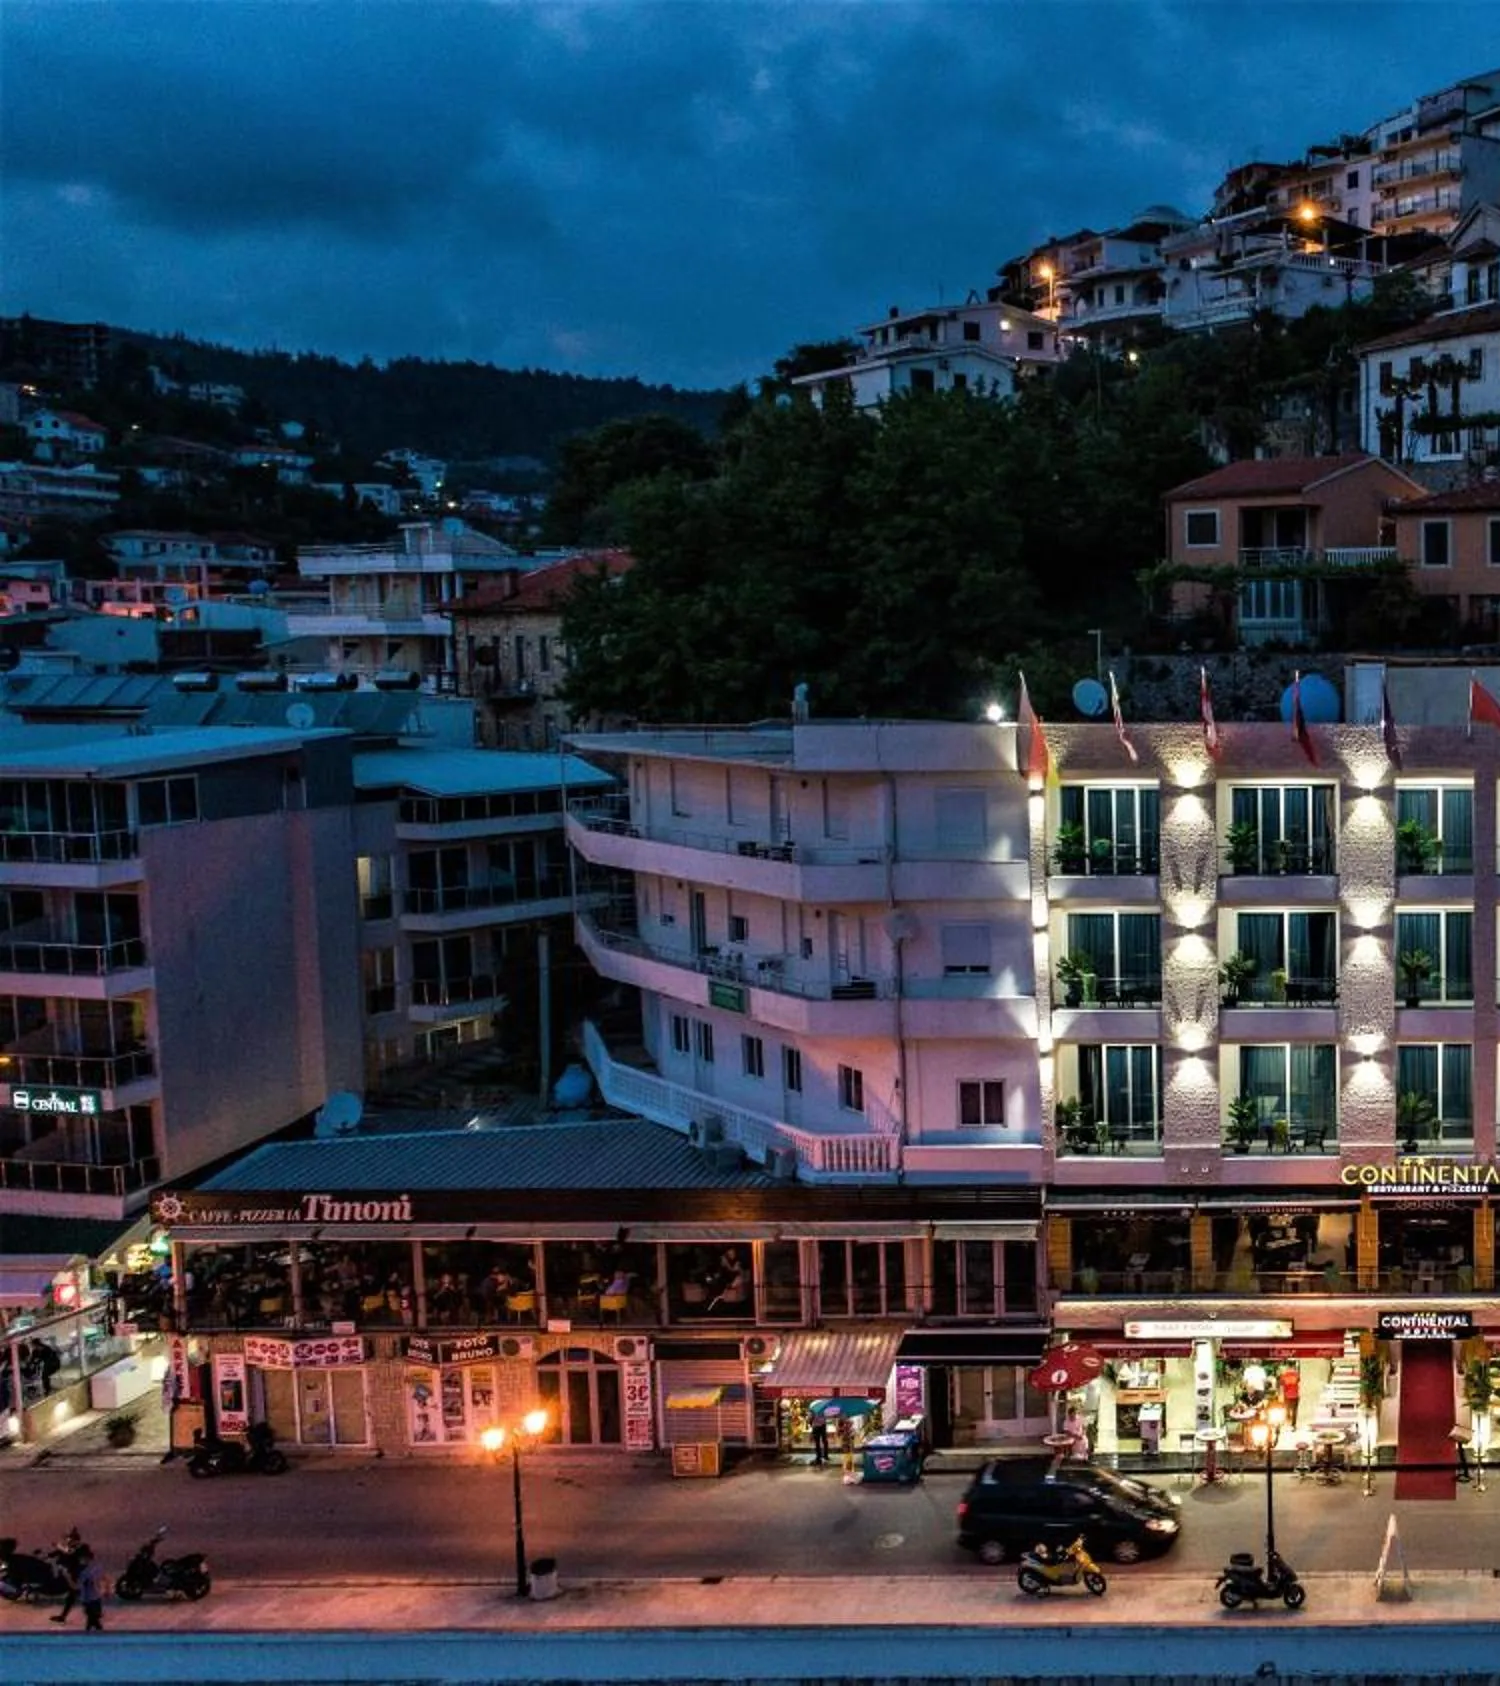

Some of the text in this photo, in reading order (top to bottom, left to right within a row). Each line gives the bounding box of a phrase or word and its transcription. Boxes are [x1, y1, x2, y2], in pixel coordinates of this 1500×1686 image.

[31, 1092, 78, 1113] CENTRAL
[302, 1194, 413, 1222] Timoni
[1381, 1315, 1469, 1328] CONTINENTAL
[456, 1336, 487, 1349] FOTO
